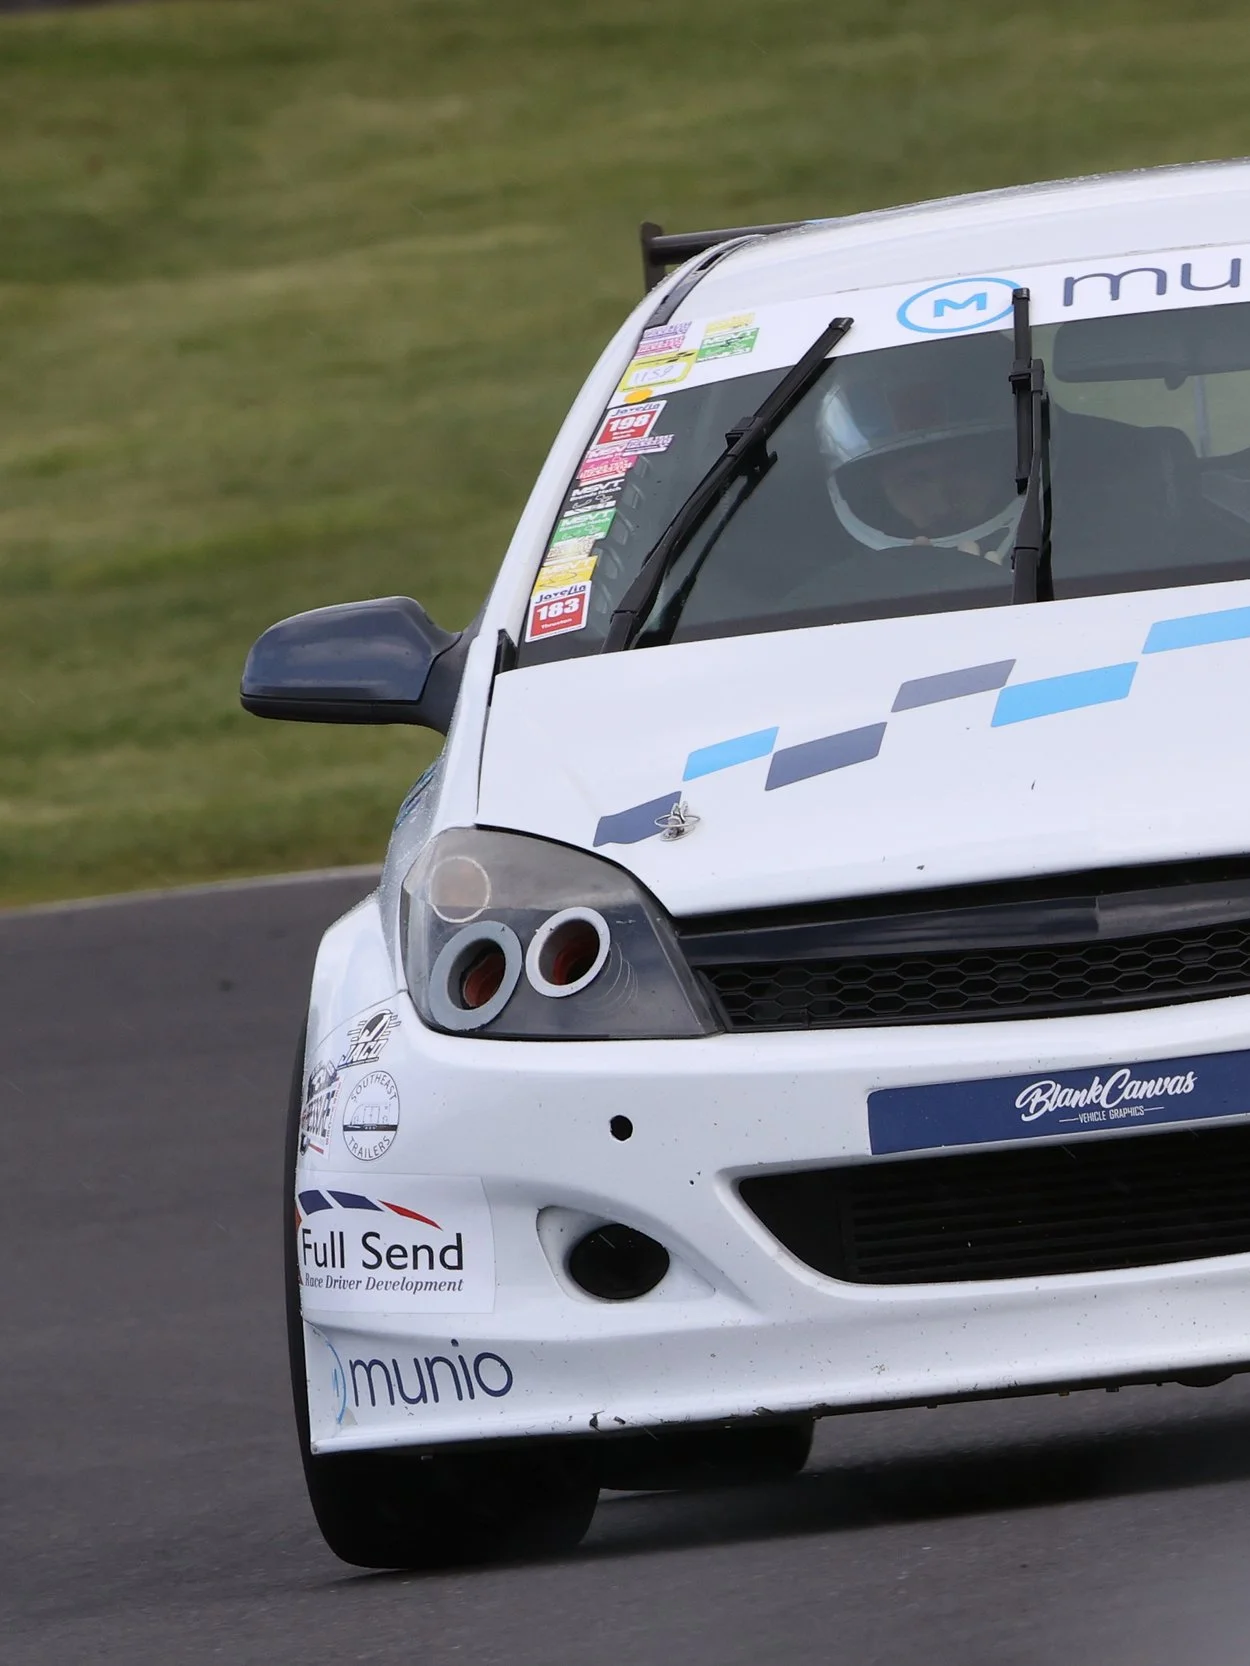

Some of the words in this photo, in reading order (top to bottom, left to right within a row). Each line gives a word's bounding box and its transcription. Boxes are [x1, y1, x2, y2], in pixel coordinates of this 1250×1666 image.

[609, 413, 651, 432] 198
[537, 598, 580, 620] 183
[351, 1073, 398, 1102] SOUTHEAST
[1078, 1111, 1107, 1124] VEHICLE
[1109, 1105, 1145, 1119] GRAPHICS
[348, 1135, 391, 1158] TRAILERS
[302, 1228, 345, 1269] Full
[361, 1231, 463, 1270] Send
[305, 1273, 323, 1288] Race
[325, 1275, 362, 1290] Driver
[365, 1276, 464, 1294] Development
[349, 1339, 513, 1407] munio
